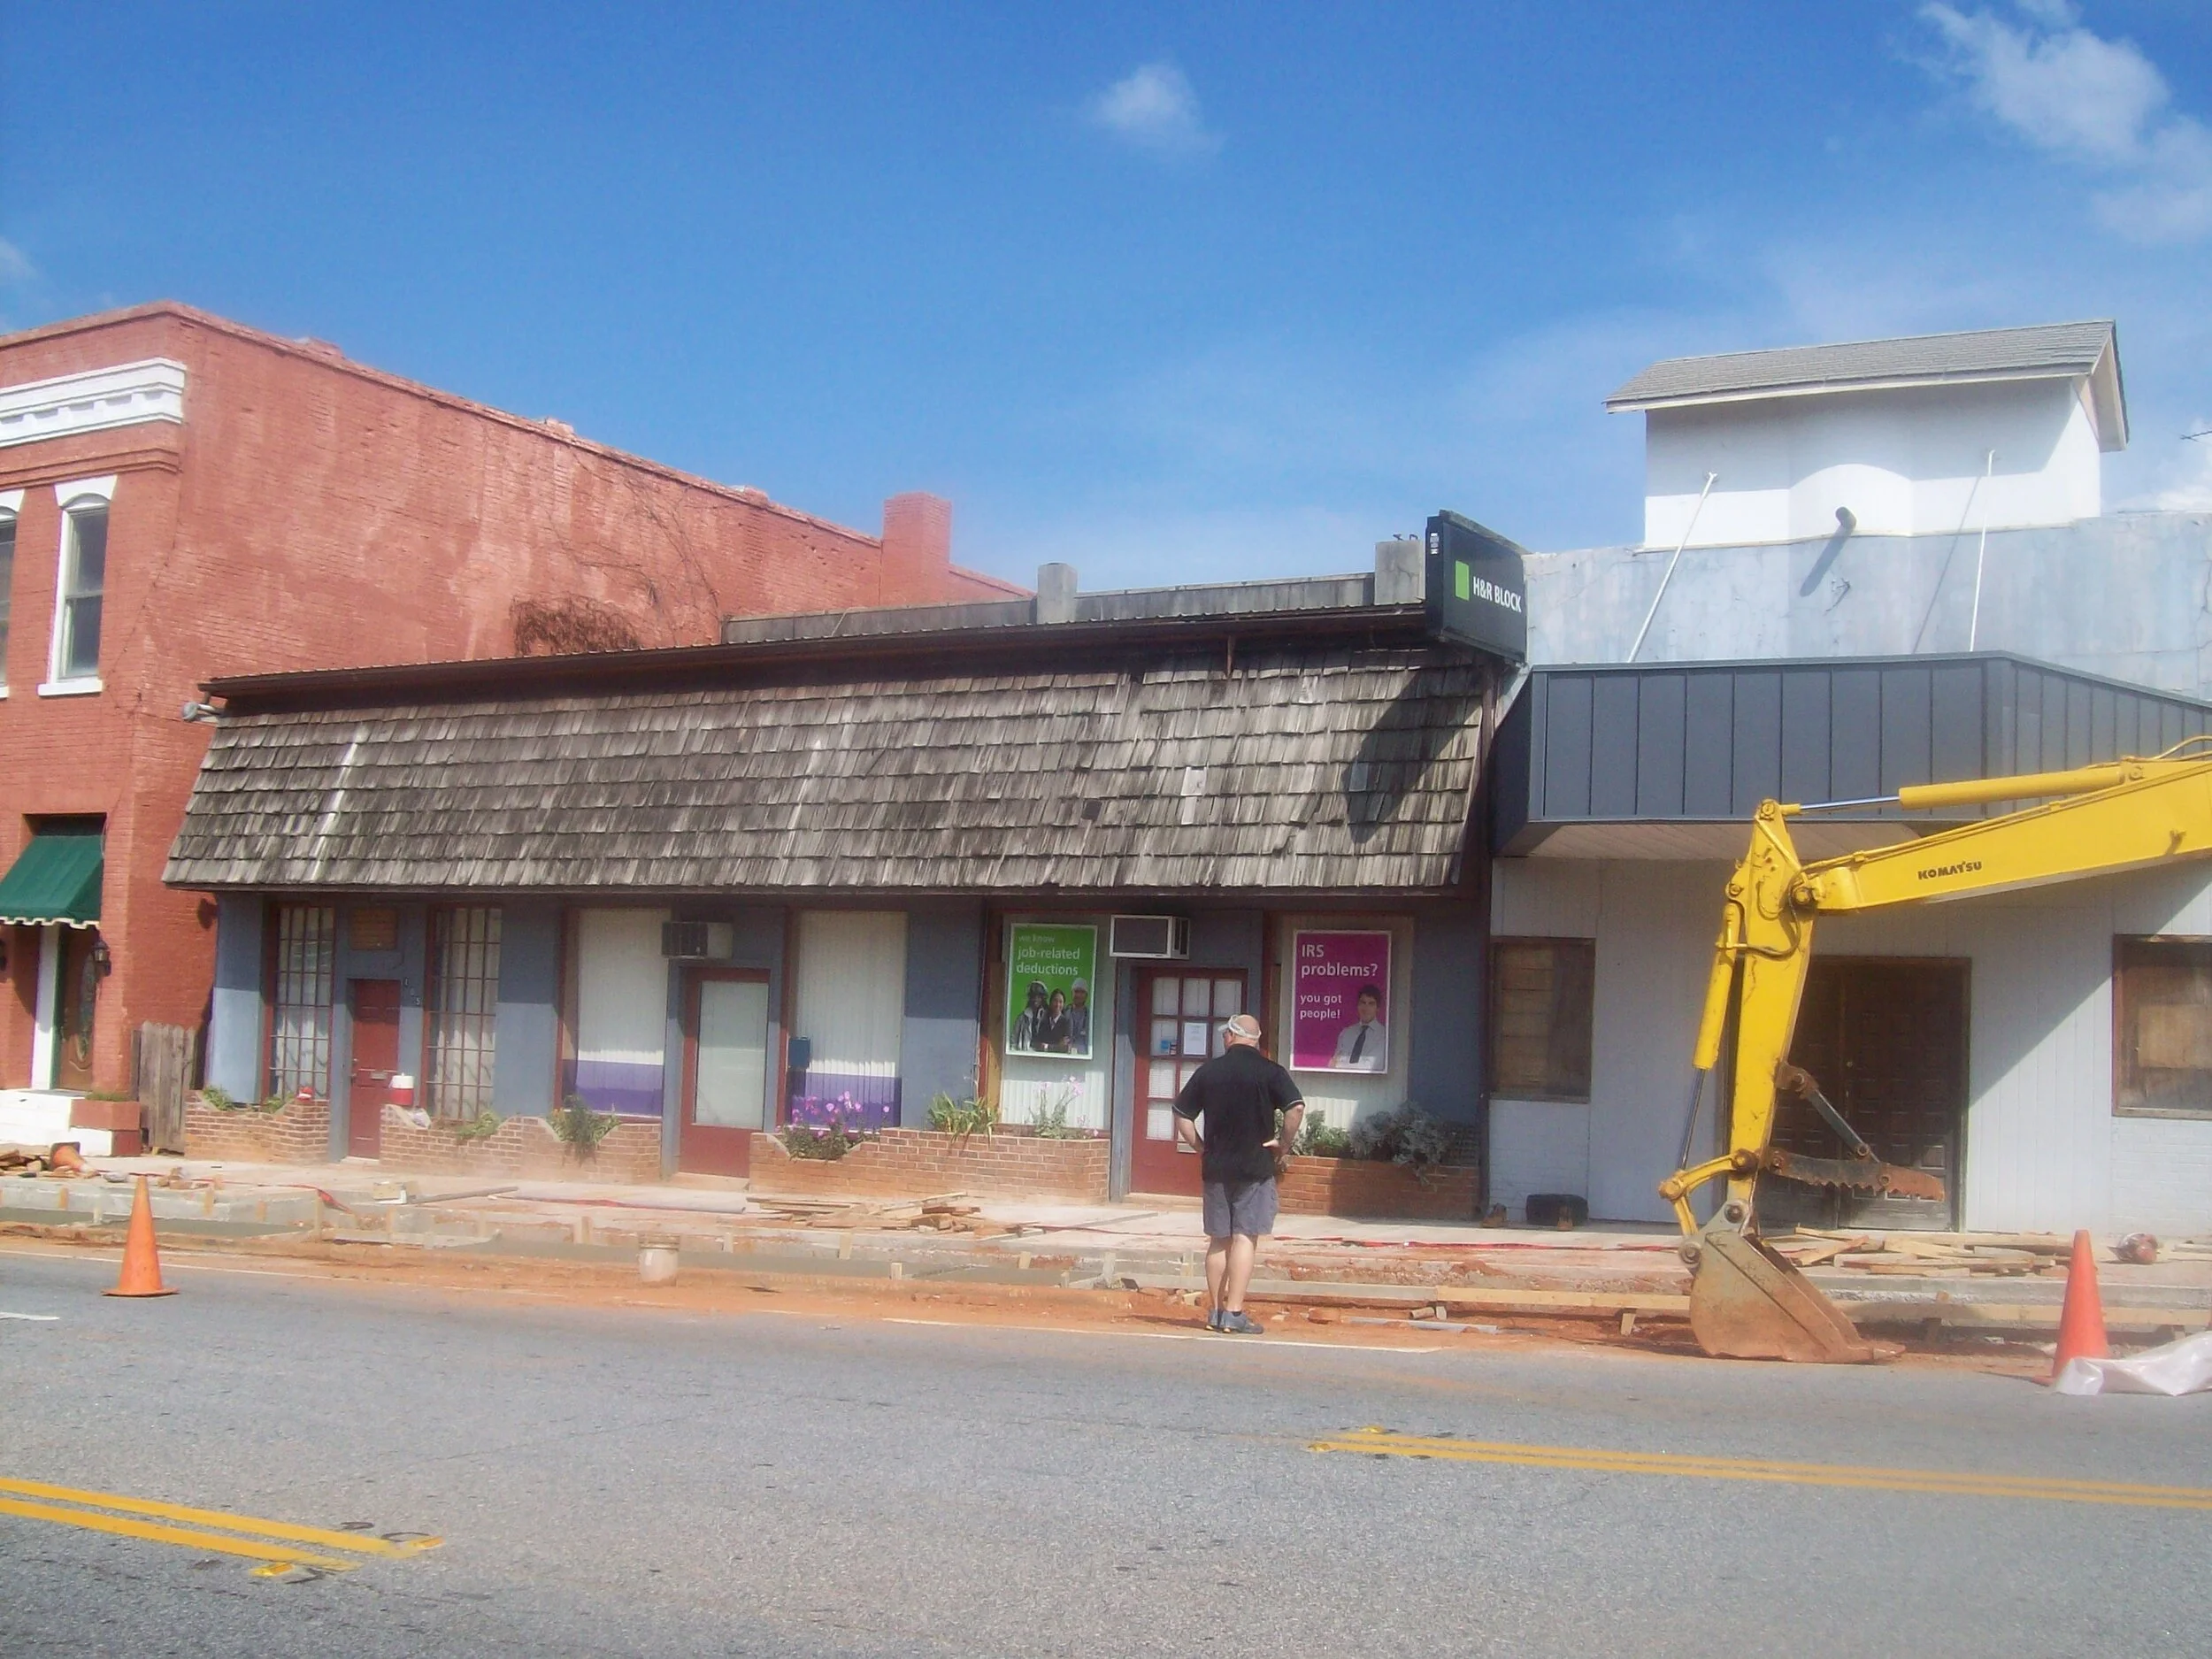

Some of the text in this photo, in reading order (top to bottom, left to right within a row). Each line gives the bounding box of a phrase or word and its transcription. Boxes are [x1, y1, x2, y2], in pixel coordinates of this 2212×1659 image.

[1473, 576, 1522, 612] H&R BLOCK
[1917, 861, 1982, 880] KOMATSU
[1018, 946, 1080, 961] job-related
[1302, 944, 1325, 958] IRS
[1016, 962, 1079, 975] deductions
[1302, 963, 1378, 979] problems?
[1300, 994, 1342, 1005] you got
[1300, 1009, 1340, 1021] people!
